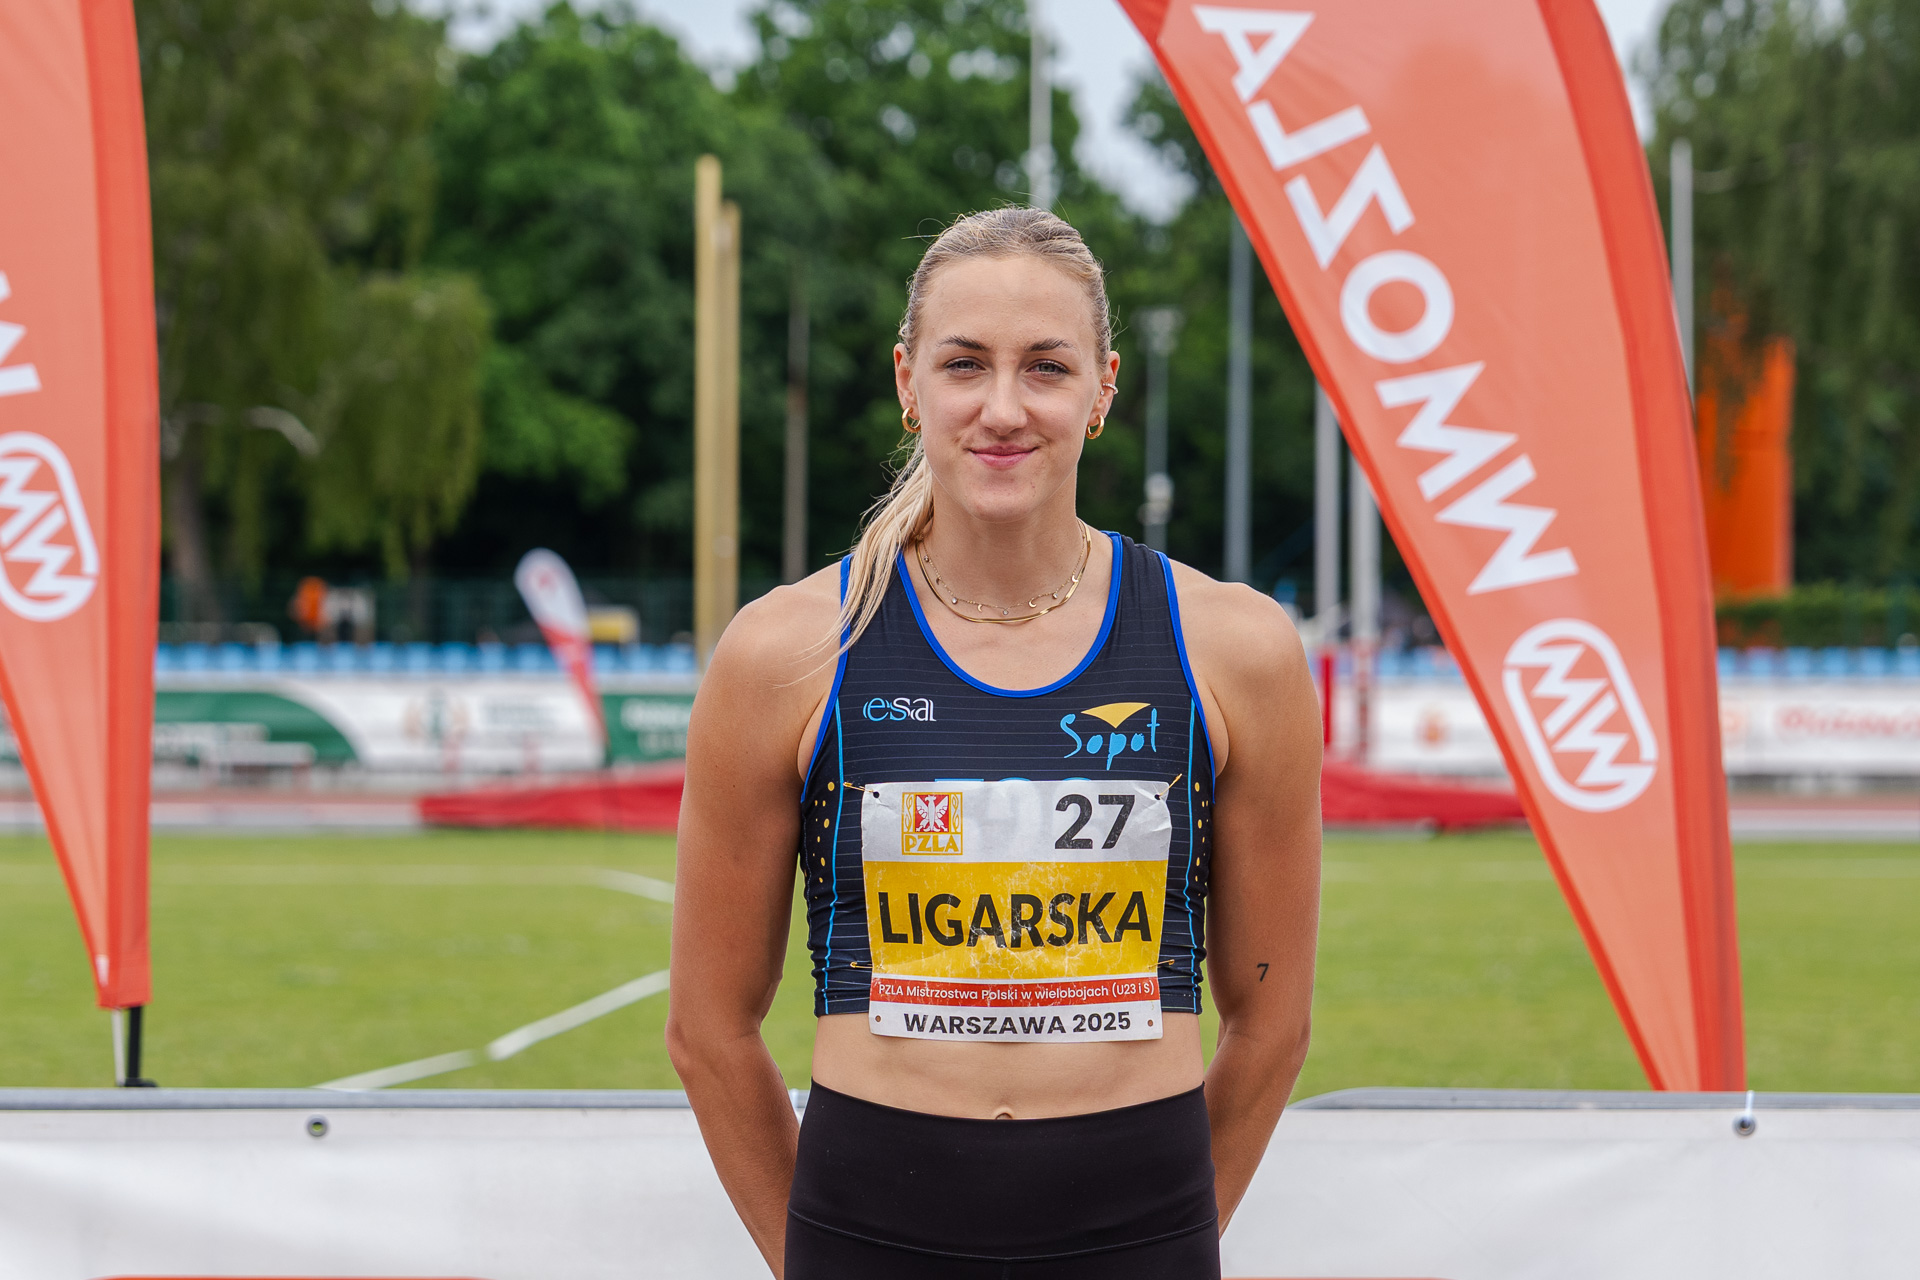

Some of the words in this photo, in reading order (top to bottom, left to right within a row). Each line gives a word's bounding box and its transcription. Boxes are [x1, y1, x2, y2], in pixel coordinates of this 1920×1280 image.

[863, 697, 937, 722] esa
[1059, 707, 1161, 771] Sopot
[1054, 793, 1136, 850] 27
[904, 833, 961, 853] PZLA
[877, 890, 1153, 949] LIGARSKA
[1256, 962, 1270, 983] 7
[878, 984, 904, 996] PZLA
[906, 985, 978, 1000] Mistrzostwa
[981, 988, 1018, 1000] Polski
[1020, 990, 1032, 1000] w
[1034, 984, 1109, 1001] wielobojach
[1111, 981, 1137, 998] (U23
[1143, 979, 1155, 996] S)
[903, 1013, 1067, 1035] WARSZAWA
[1072, 1011, 1131, 1033] 2025
